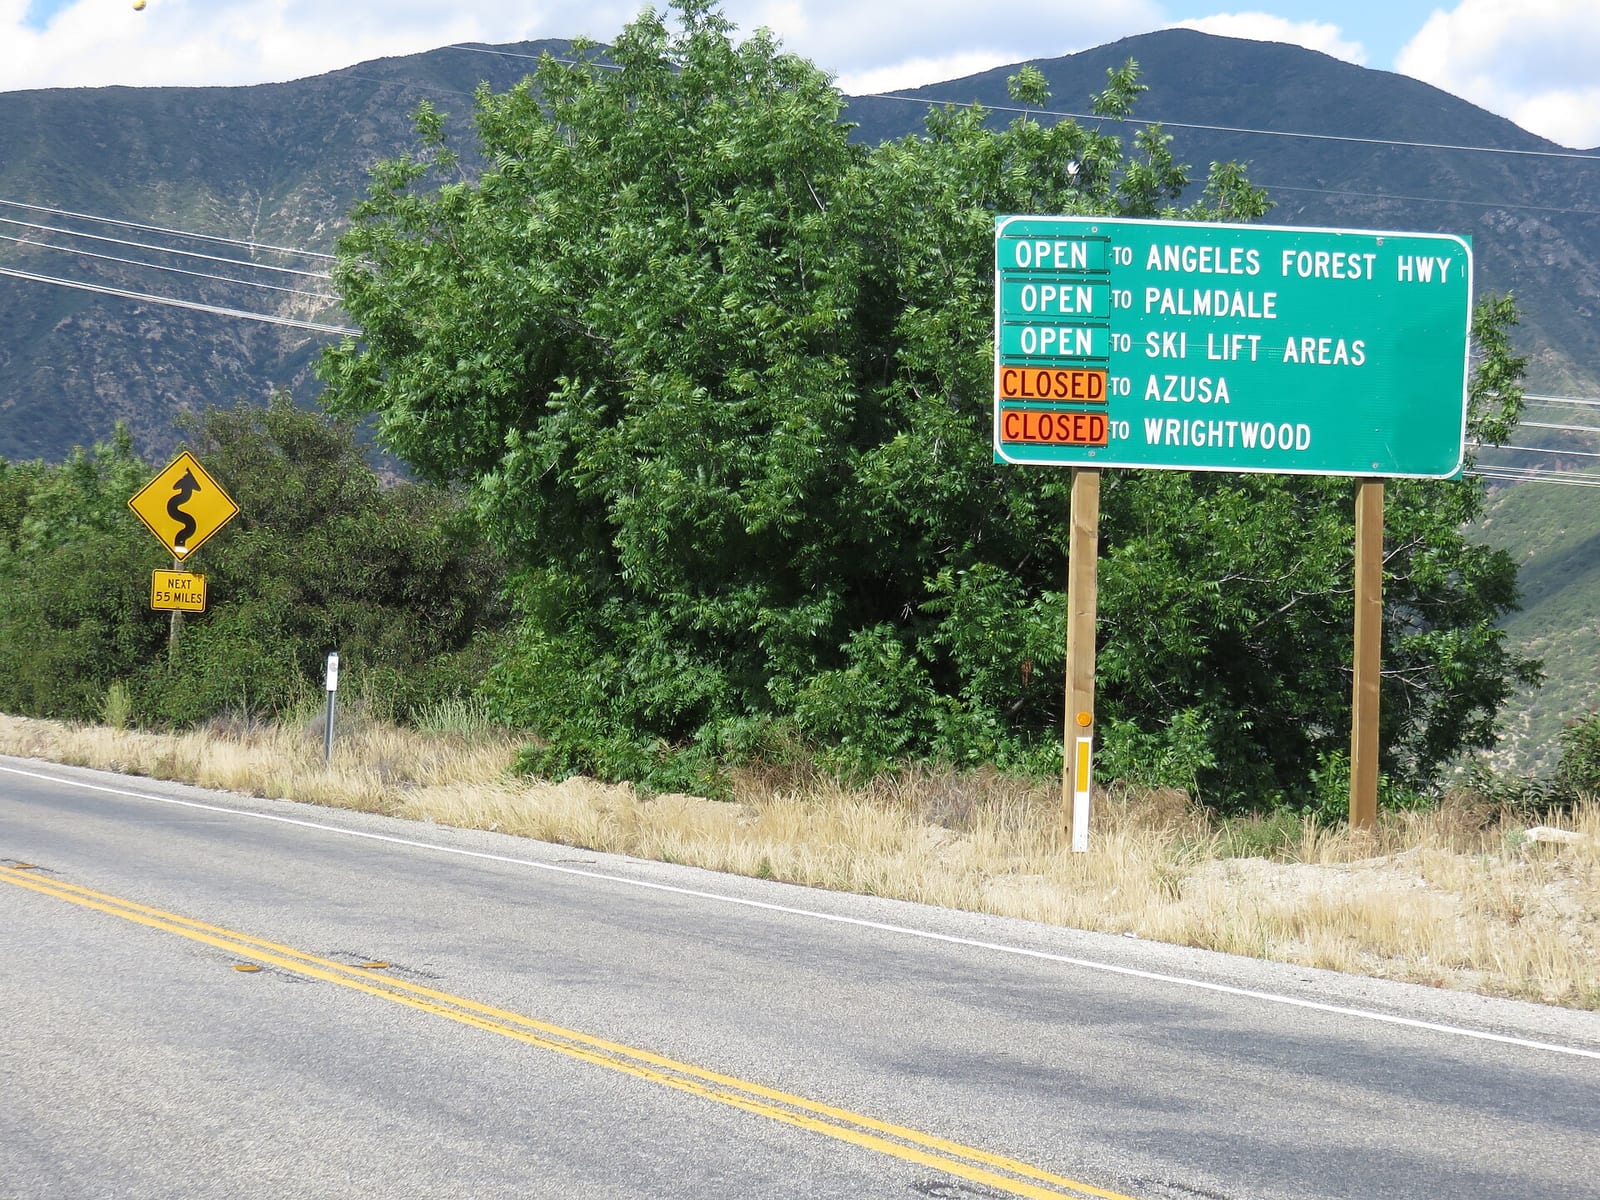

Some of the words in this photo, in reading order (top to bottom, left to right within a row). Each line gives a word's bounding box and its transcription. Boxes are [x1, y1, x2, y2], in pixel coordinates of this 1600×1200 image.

[1015, 241, 1087, 269] OPEN
[1113, 246, 1132, 266] TO
[1146, 244, 1261, 276] ANGELES
[1282, 250, 1377, 280] FOREST
[1397, 255, 1452, 284] HWY
[1021, 285, 1093, 314] OPEN
[1112, 289, 1132, 309] TO
[1145, 288, 1277, 319] PALMDALE
[1020, 327, 1092, 356] OPEN
[1111, 333, 1131, 352] TO
[1145, 331, 1187, 358] SKI
[1207, 333, 1262, 362] LIFT
[1282, 336, 1366, 366] AREAS
[1003, 369, 1102, 399] CLOSED
[1111, 377, 1131, 396] TO
[1144, 374, 1230, 404] AZUSA
[1005, 413, 1105, 442] CLOSED
[1110, 420, 1130, 440] TO
[1144, 418, 1311, 450] WRIGHTWOOD
[156, 591, 171, 602] 55
[174, 592, 202, 604] MILES
[168, 578, 192, 589] NEXT
